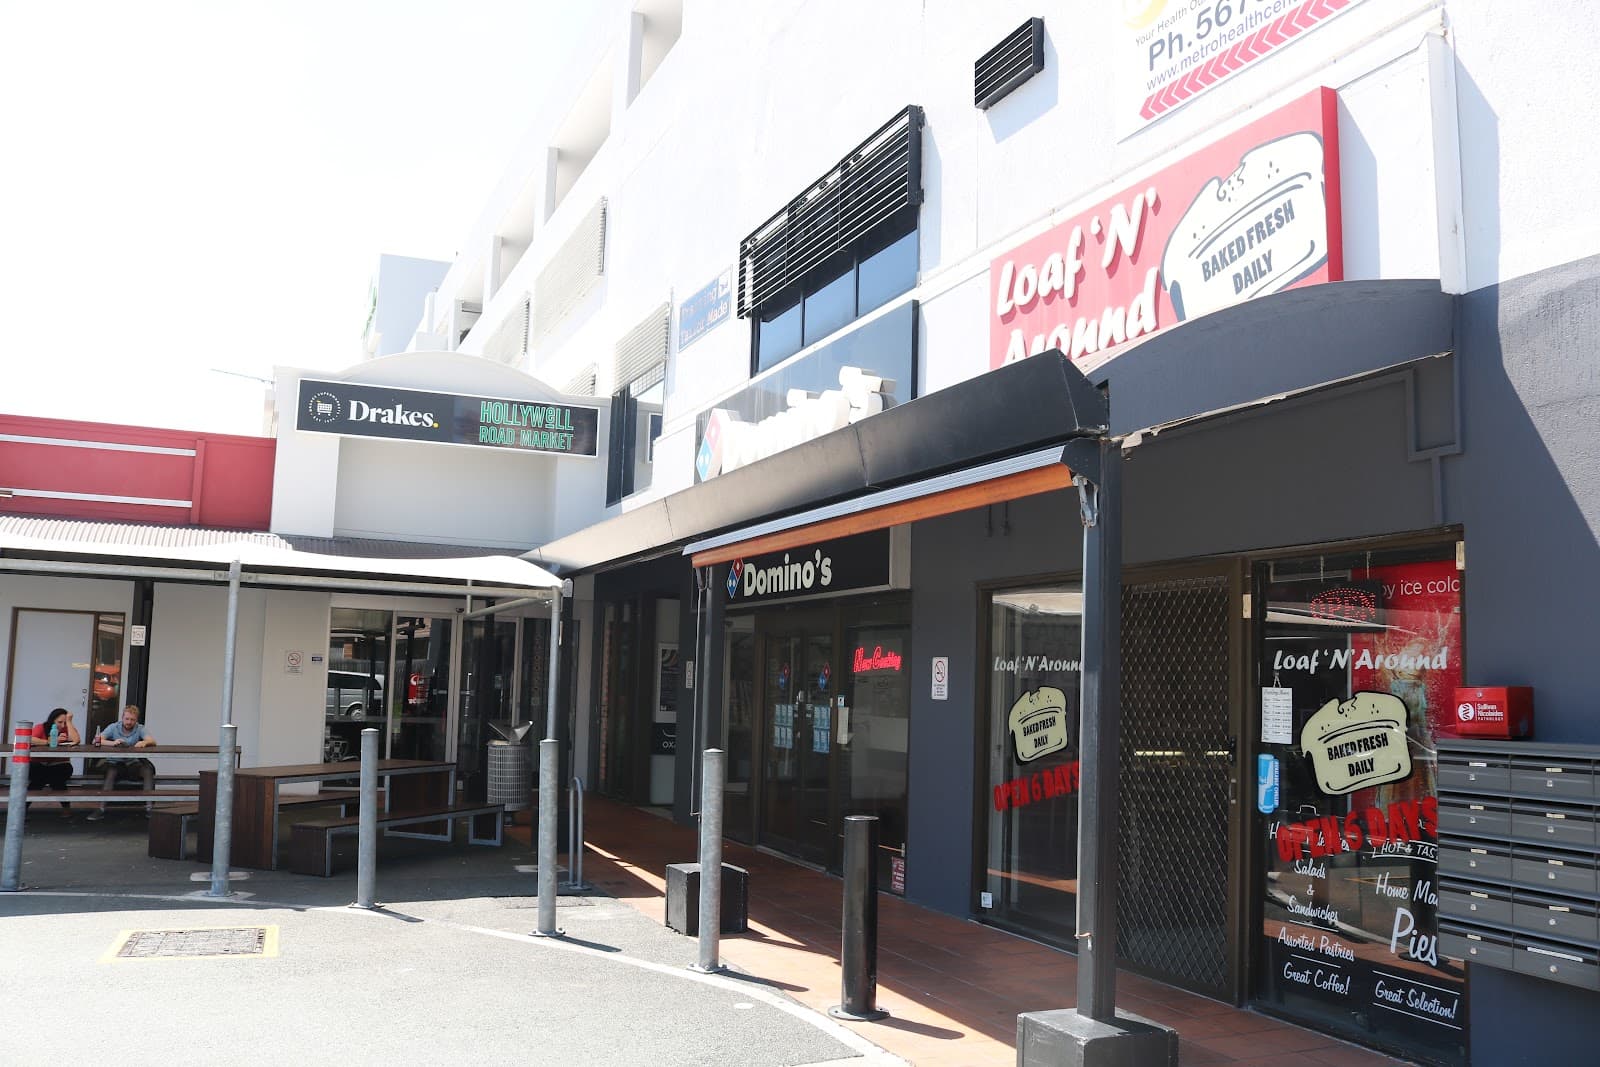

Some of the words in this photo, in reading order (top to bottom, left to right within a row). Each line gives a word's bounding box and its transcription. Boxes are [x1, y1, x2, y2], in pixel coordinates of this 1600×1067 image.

[1136, 29, 1154, 46] Your
[1157, 8, 1188, 32] Health
[1189, 0, 1205, 11] Ou
[1146, 0, 1296, 91] www.metrohealthcen
[1201, 230, 1247, 283] BAKED
[1247, 199, 1295, 252] FRESH
[997, 225, 1084, 317] Loaf
[1232, 250, 1274, 296] DAILY
[479, 426, 515, 445] ROAD
[520, 430, 574, 450] MARKET
[743, 549, 832, 597] Domino's
[1400, 579, 1422, 596] ice
[994, 655, 1020, 675] Loaf
[1038, 655, 1083, 672] Aroun
[1273, 648, 1319, 675] Loaf
[1355, 647, 1448, 670] Around
[1022, 721, 1039, 738] BAKED
[1039, 715, 1057, 731] FRESH
[1033, 734, 1048, 749] DAILY
[1327, 736, 1358, 762] BAKED
[1357, 732, 1388, 754] FRESH
[1348, 758, 1374, 778] DAILY
[994, 777, 1030, 812] OPEN
[1031, 772, 1042, 802] 6
[1042, 760, 1079, 800] DAYS
[1276, 814, 1342, 862] OPEN
[1366, 795, 1438, 846] DAYS
[1416, 844, 1438, 861] TAS
[1294, 859, 1326, 880] Salads
[1307, 884, 1315, 896] &
[1376, 871, 1409, 900] Home
[1414, 880, 1438, 906] Ma
[1286, 897, 1339, 923] Sandwiches
[1278, 926, 1315, 953] Assorted
[1319, 935, 1355, 962] Pastries
[1390, 907, 1437, 967] Pies
[1283, 962, 1310, 985] Great
[1314, 969, 1350, 995] Coffee!
[1375, 980, 1403, 1005] Great
[1406, 991, 1457, 1019] Selection!
